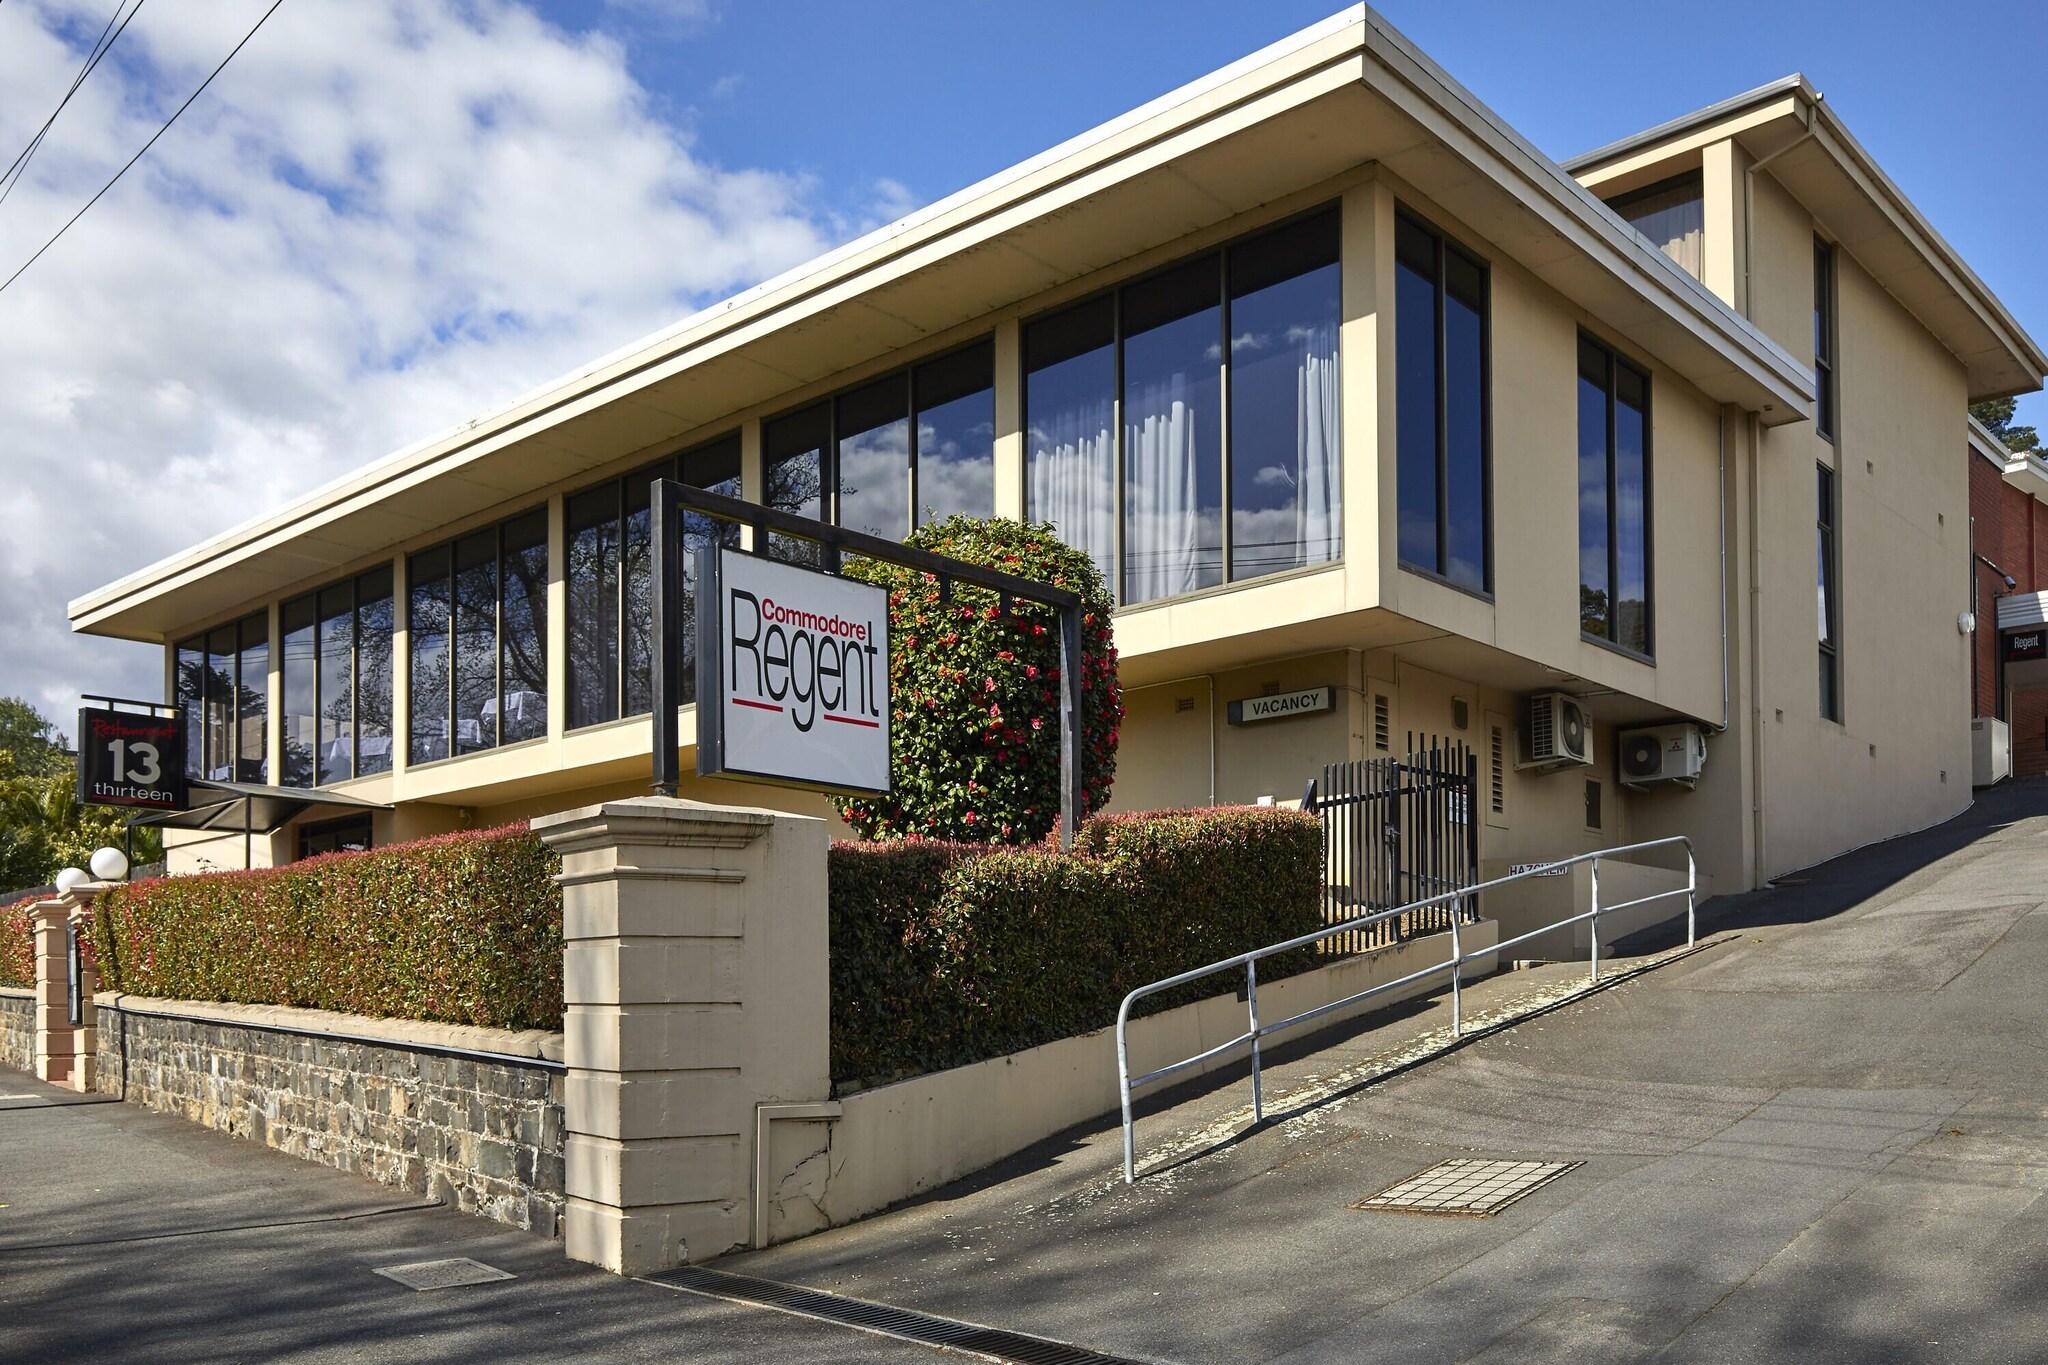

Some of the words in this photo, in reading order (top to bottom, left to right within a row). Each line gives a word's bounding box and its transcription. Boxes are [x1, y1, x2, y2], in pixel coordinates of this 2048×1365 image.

[761, 597, 866, 641] Commodore
[2014, 633, 2039, 650] Regent
[730, 587, 880, 733] Regent
[1252, 693, 1320, 716] VACANCY
[107, 738, 161, 785] 13
[94, 781, 174, 802] thirteen
